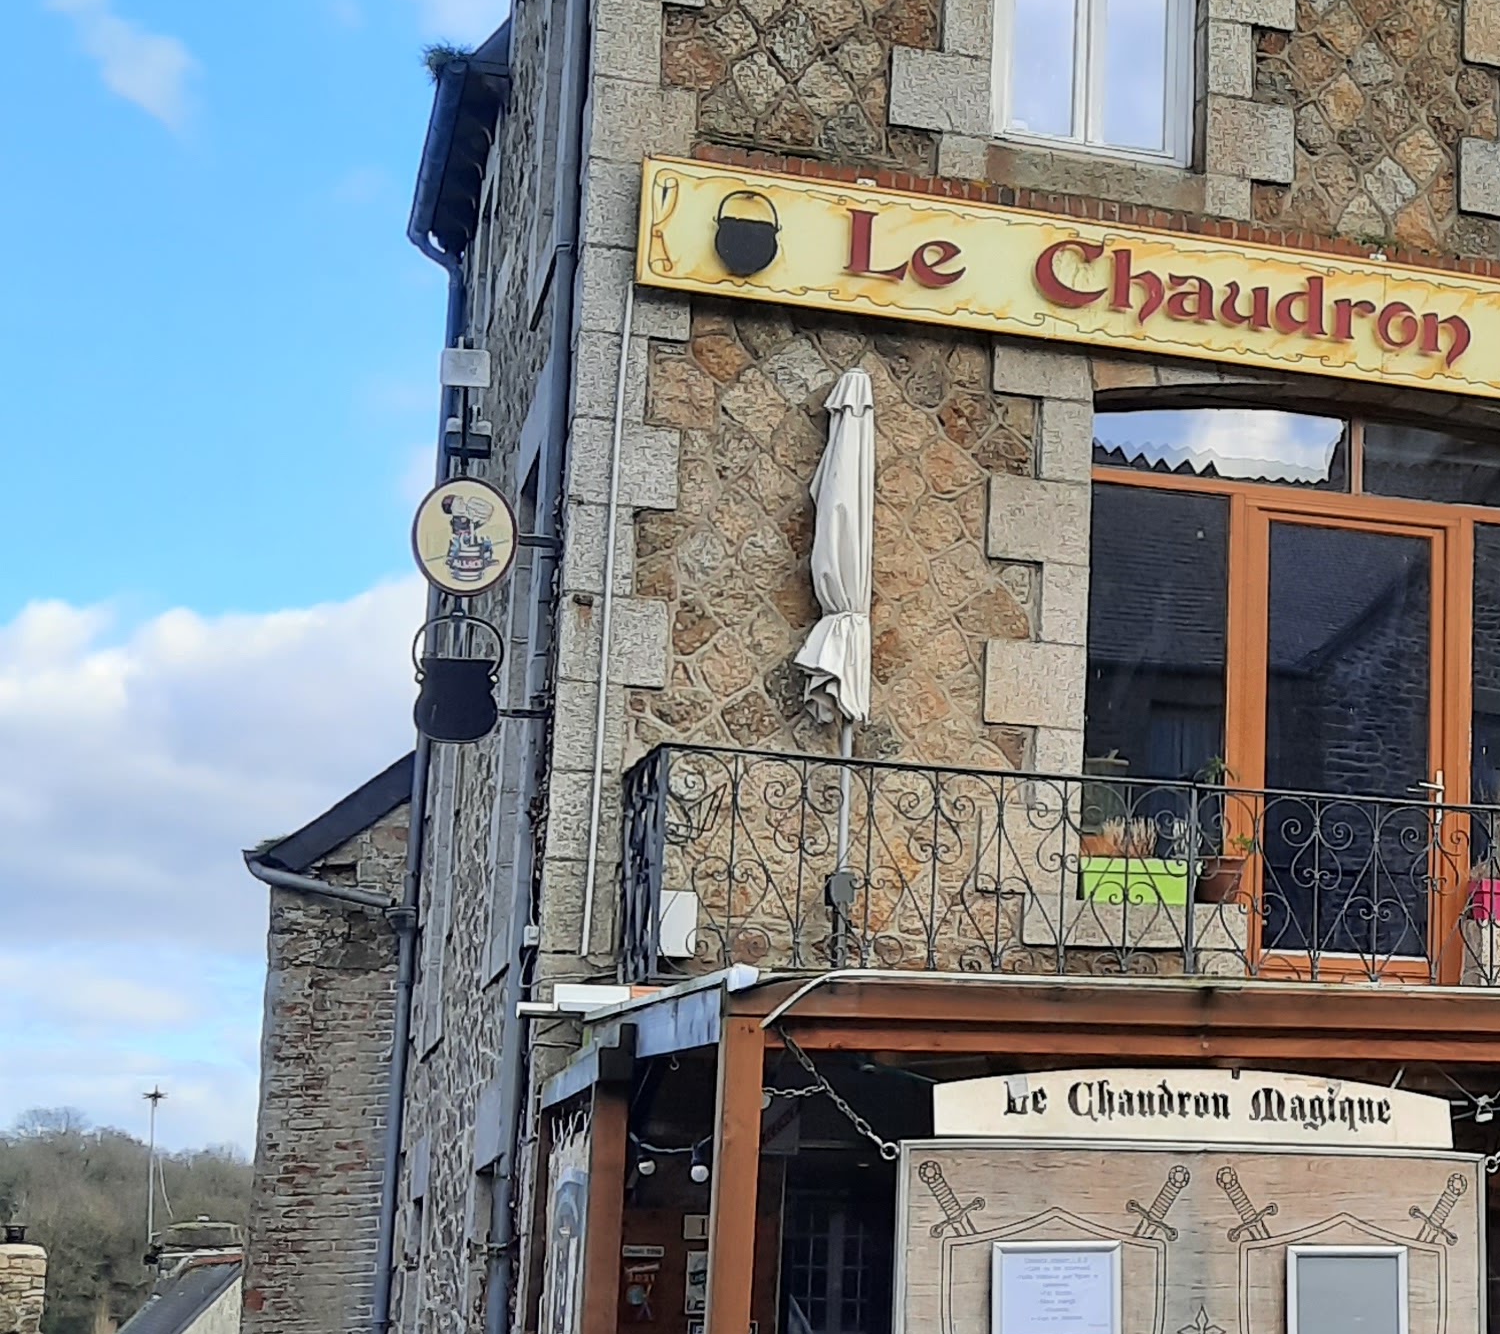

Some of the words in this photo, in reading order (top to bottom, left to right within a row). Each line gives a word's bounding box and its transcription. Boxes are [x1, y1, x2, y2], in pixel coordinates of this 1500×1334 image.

[844, 208, 967, 289] Le
[1034, 237, 1472, 368] Chaudron
[1003, 1080, 1047, 1117] Le
[1067, 1078, 1231, 1124] Chaudron
[1248, 1086, 1391, 1132] Magique
